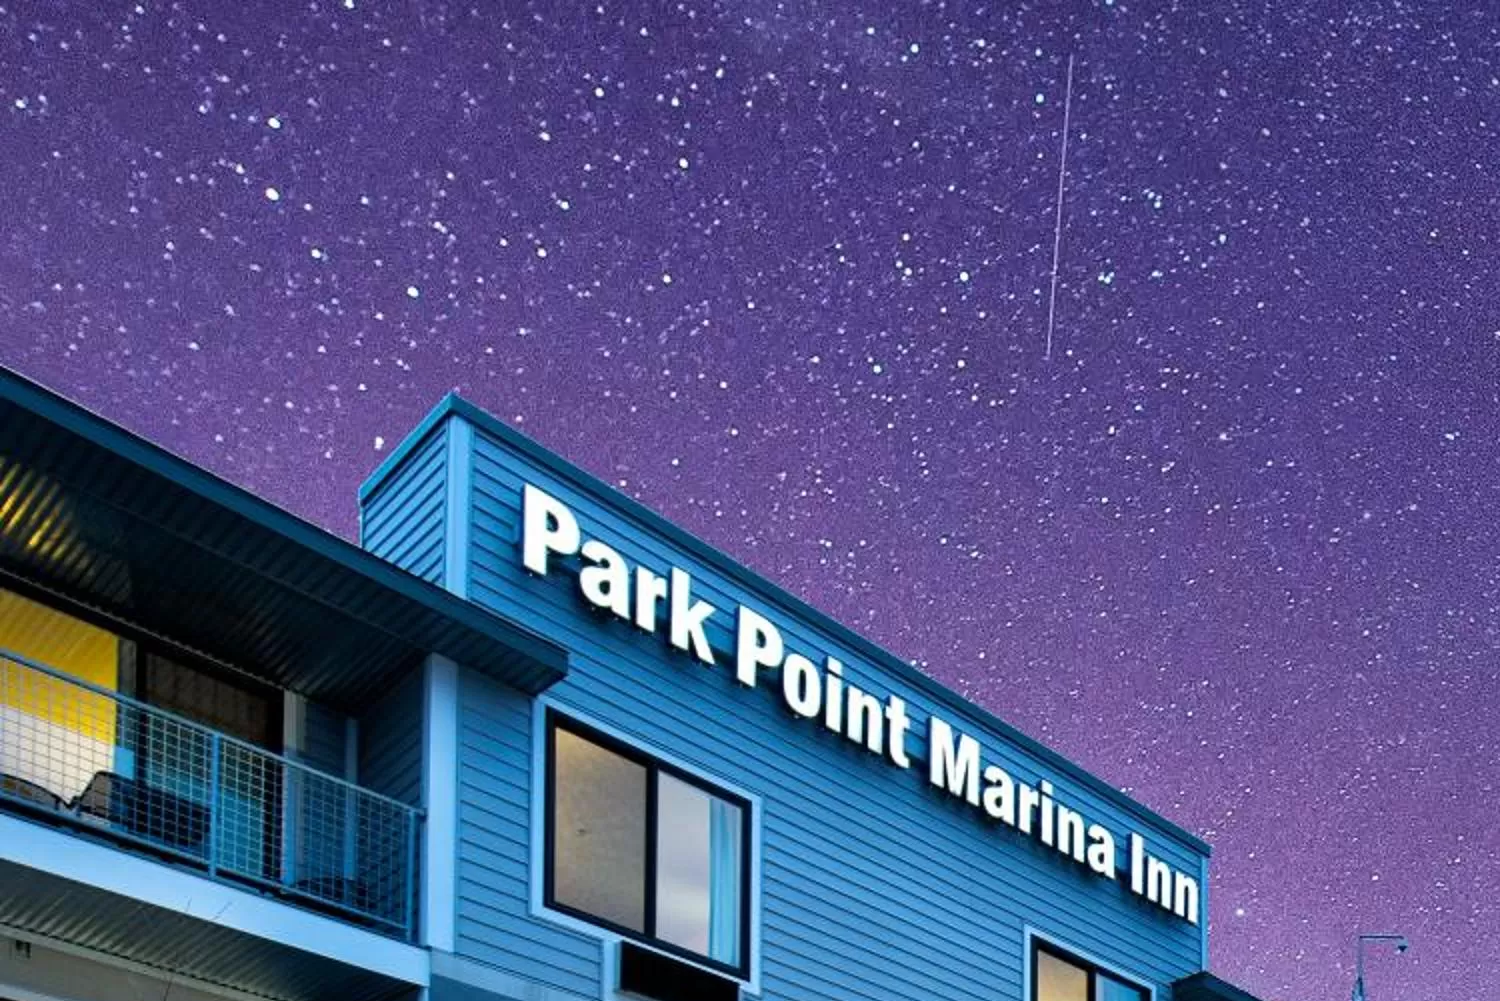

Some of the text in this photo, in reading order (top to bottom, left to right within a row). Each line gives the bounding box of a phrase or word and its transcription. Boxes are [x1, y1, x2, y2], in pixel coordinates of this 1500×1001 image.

[522, 483, 1199, 924] Park Point Marina Inn
